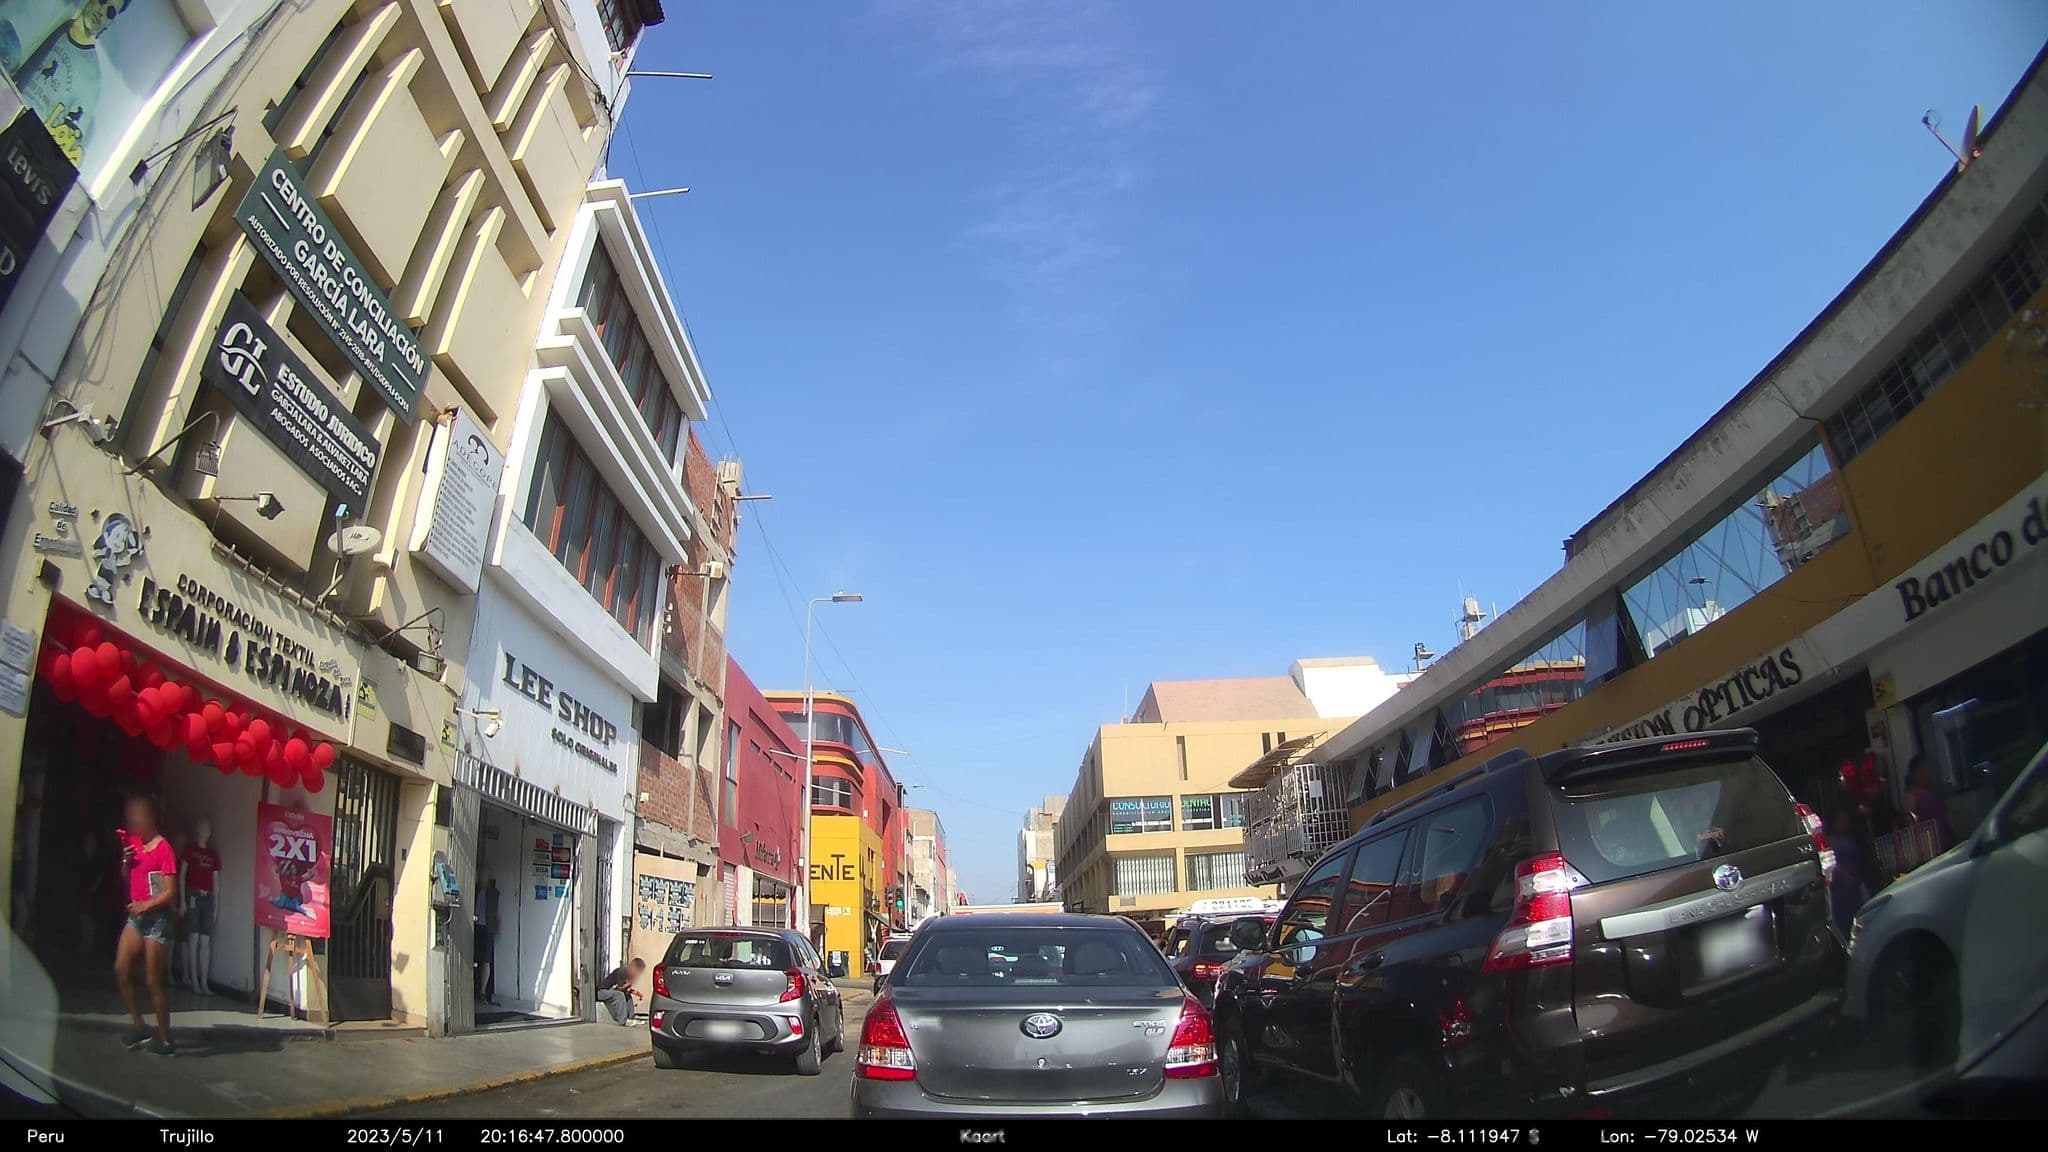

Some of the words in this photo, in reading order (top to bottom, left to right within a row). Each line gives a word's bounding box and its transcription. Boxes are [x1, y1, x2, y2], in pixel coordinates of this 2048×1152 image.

[248, 215, 286, 265] AUTORIZADO
[285, 260, 301, 282] POR
[272, 169, 325, 244] CENTRO
[323, 239, 346, 272] DE
[343, 267, 424, 375] CONCILIACIÓN
[294, 240, 348, 317] GARCÍA
[347, 308, 385, 363] LARA
[276, 363, 329, 422] ESTUDIO
[270, 407, 309, 447] ABOGADOS
[309, 442, 347, 482] ASOCIADOS
[296, 413, 317, 439] LARA
[315, 432, 324, 444] &
[349, 463, 367, 486] LARA
[56, 520, 67, 530] de
[1895, 530, 2013, 623] Banco
[177, 573, 273, 643] CORPORACION
[275, 632, 315, 668] TEXTIL
[245, 640, 343, 716] ESPINOZA
[502, 652, 553, 709] LEE
[558, 691, 617, 745] SHOP
[551, 727, 574, 748] SOLO
[270, 833, 317, 862] 2X1
